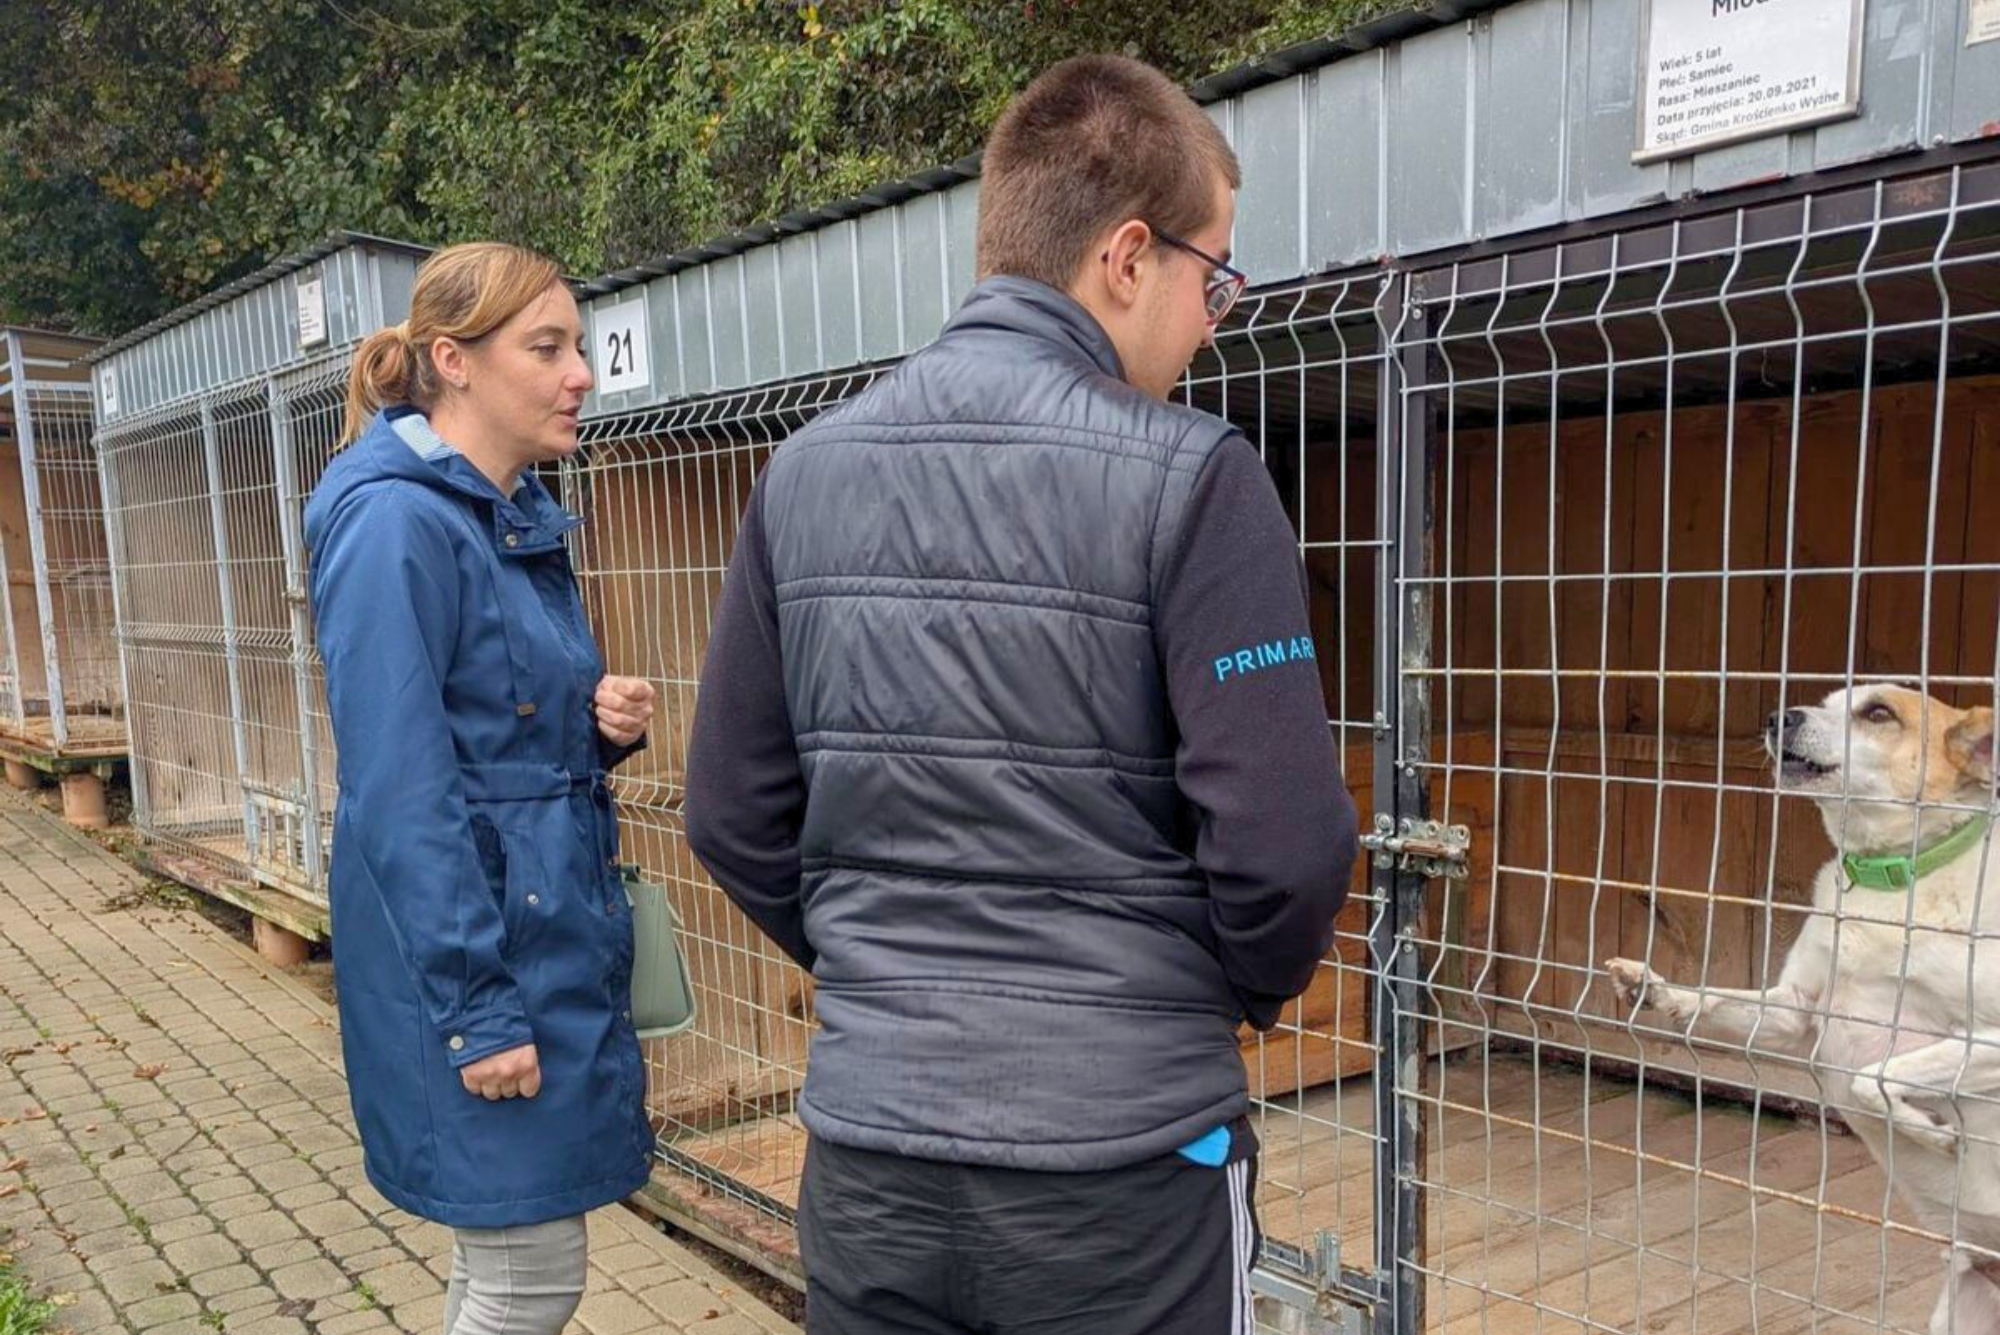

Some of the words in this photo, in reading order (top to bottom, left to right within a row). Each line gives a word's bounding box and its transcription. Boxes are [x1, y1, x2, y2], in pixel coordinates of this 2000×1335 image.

[1660, 54, 1692, 71] Wiek:
[1696, 50, 1703, 62] 5
[1706, 46, 1722, 59] lat
[1689, 63, 1733, 82] Samiec
[1658, 92, 1690, 108] Rasa:
[1693, 74, 1761, 98] Mieszaniec
[1658, 112, 1684, 126] Data
[1748, 75, 1816, 103] 20.09.2021
[1691, 119, 1730, 135] Gmina
[608, 327, 634, 377] 21
[1215, 636, 1315, 682] PRIMAR
